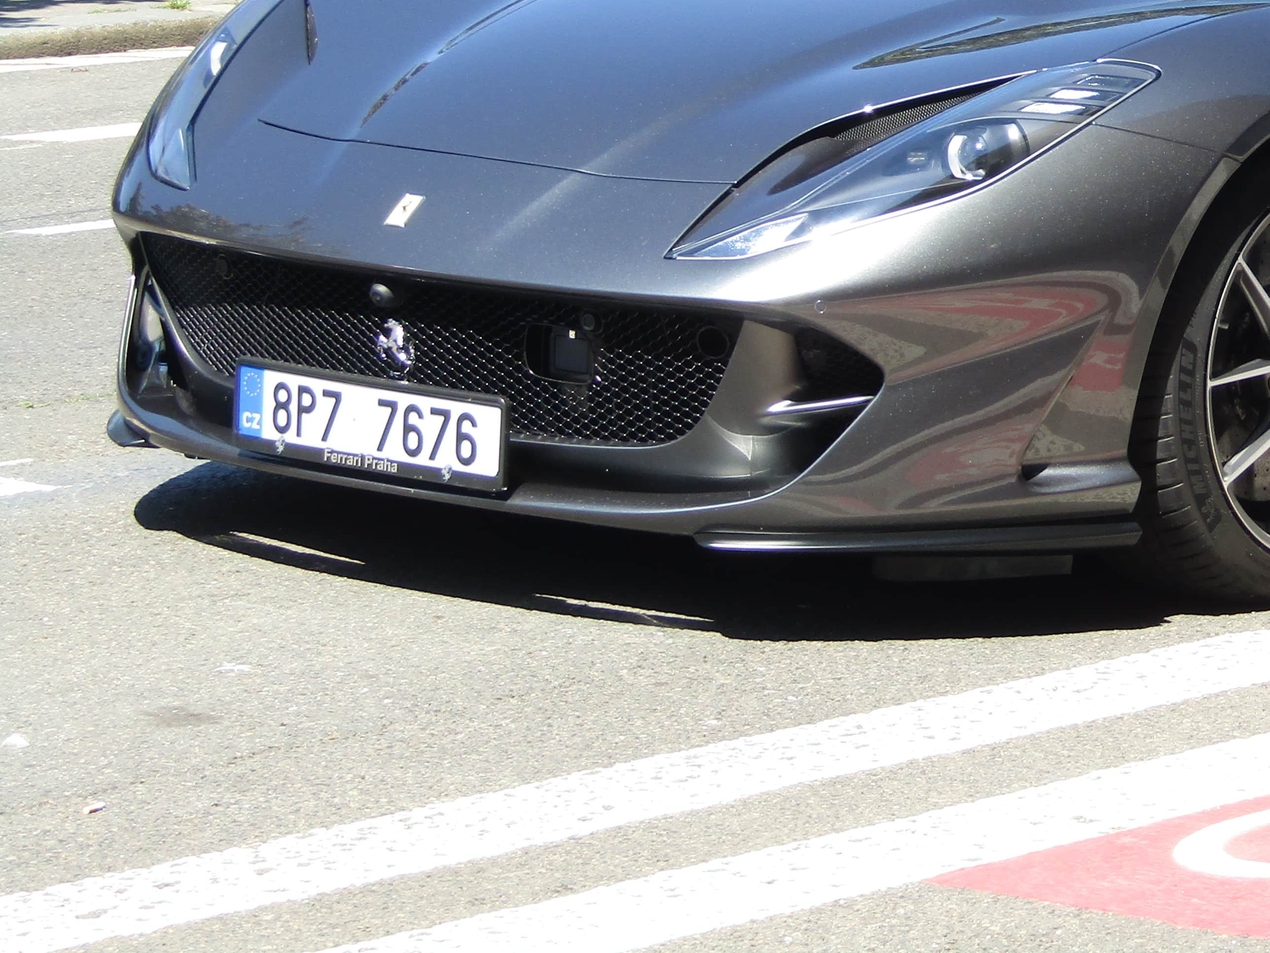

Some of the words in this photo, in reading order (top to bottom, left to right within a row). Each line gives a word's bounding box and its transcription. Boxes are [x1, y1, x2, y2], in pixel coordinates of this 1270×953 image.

[243, 411, 261, 430] CZ
[273, 381, 342, 442] 8P7
[376, 398, 478, 467] 7676
[1179, 347, 1208, 495] MICHELIN
[324, 449, 362, 467] Ferrari
[364, 455, 398, 473] Praha
